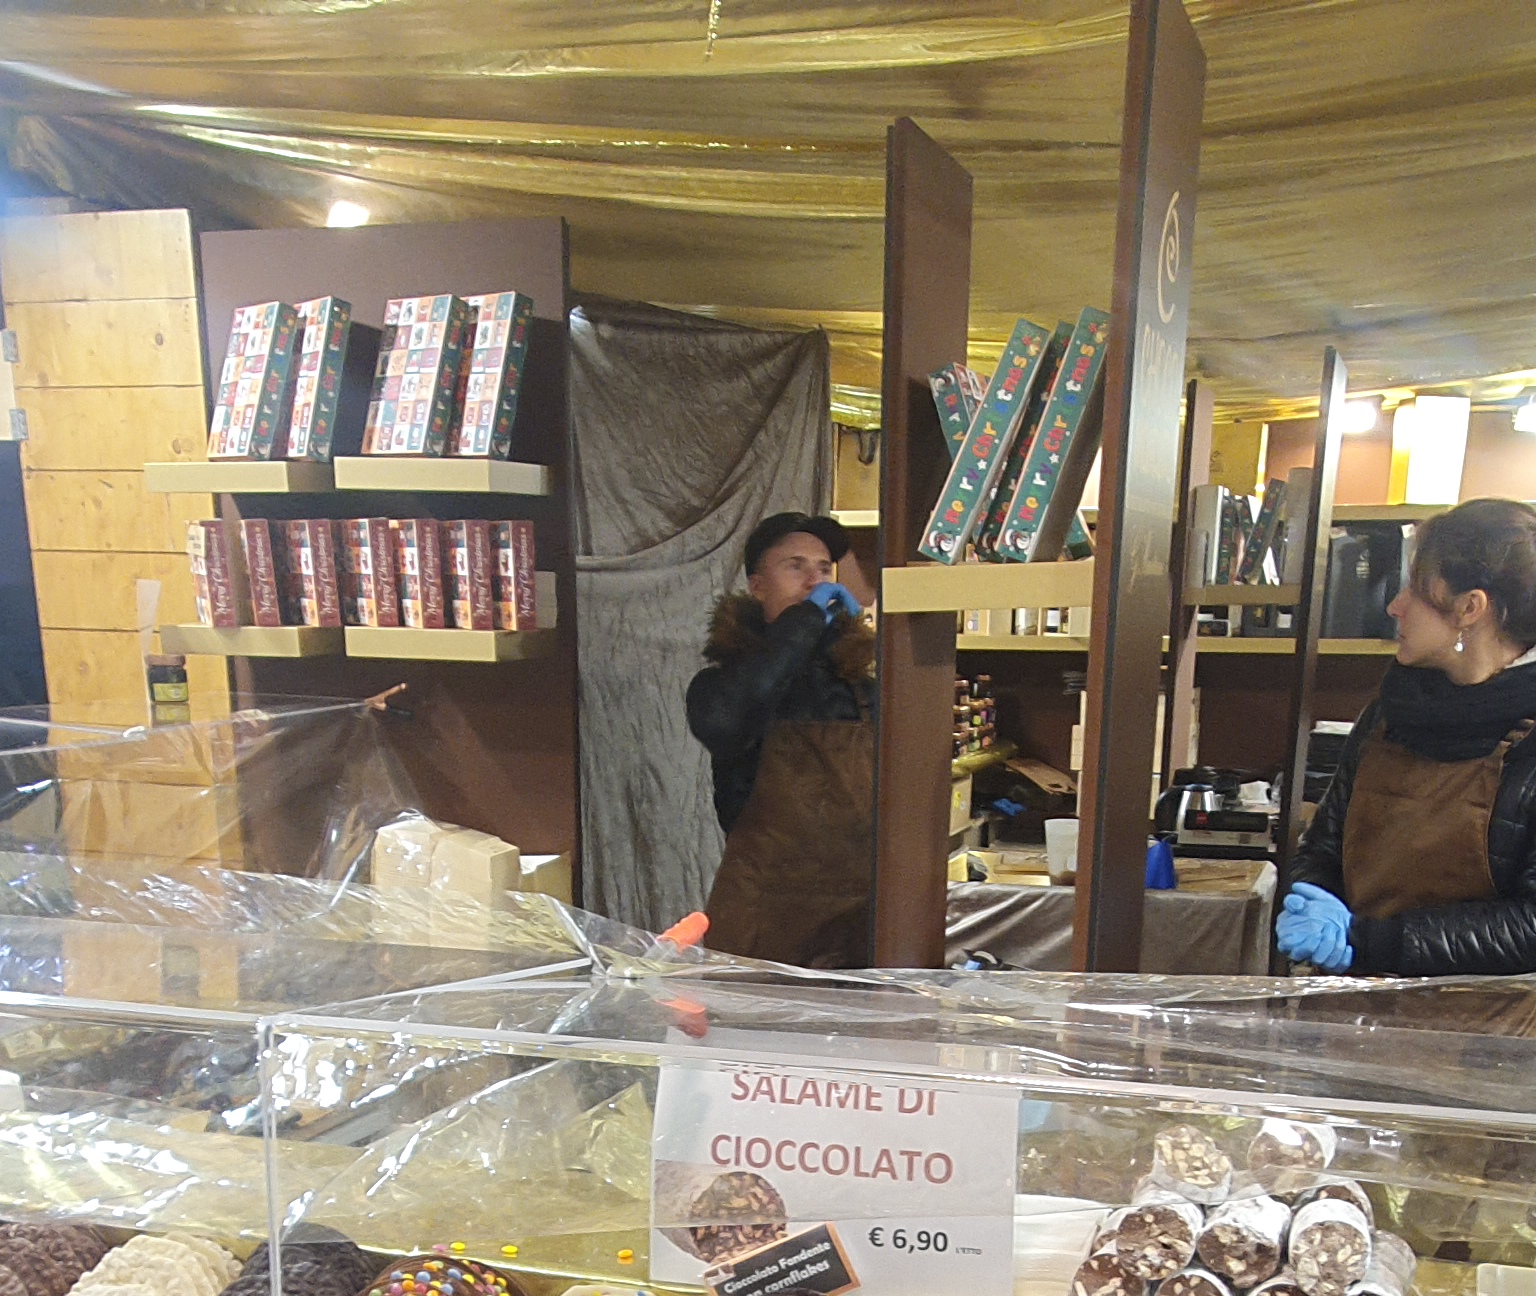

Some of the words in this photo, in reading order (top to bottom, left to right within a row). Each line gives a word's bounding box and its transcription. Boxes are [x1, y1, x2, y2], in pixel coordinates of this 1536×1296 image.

[731, 1069, 883, 1112] SALAME
[898, 1086, 936, 1116] DI
[711, 1134, 954, 1185] CIOCCOLATO
[869, 1226, 885, 1248] €
[891, 1228, 949, 1254] 6,90
[723, 1262, 780, 1295] Cioccolato
[778, 1240, 831, 1271] Fondente
